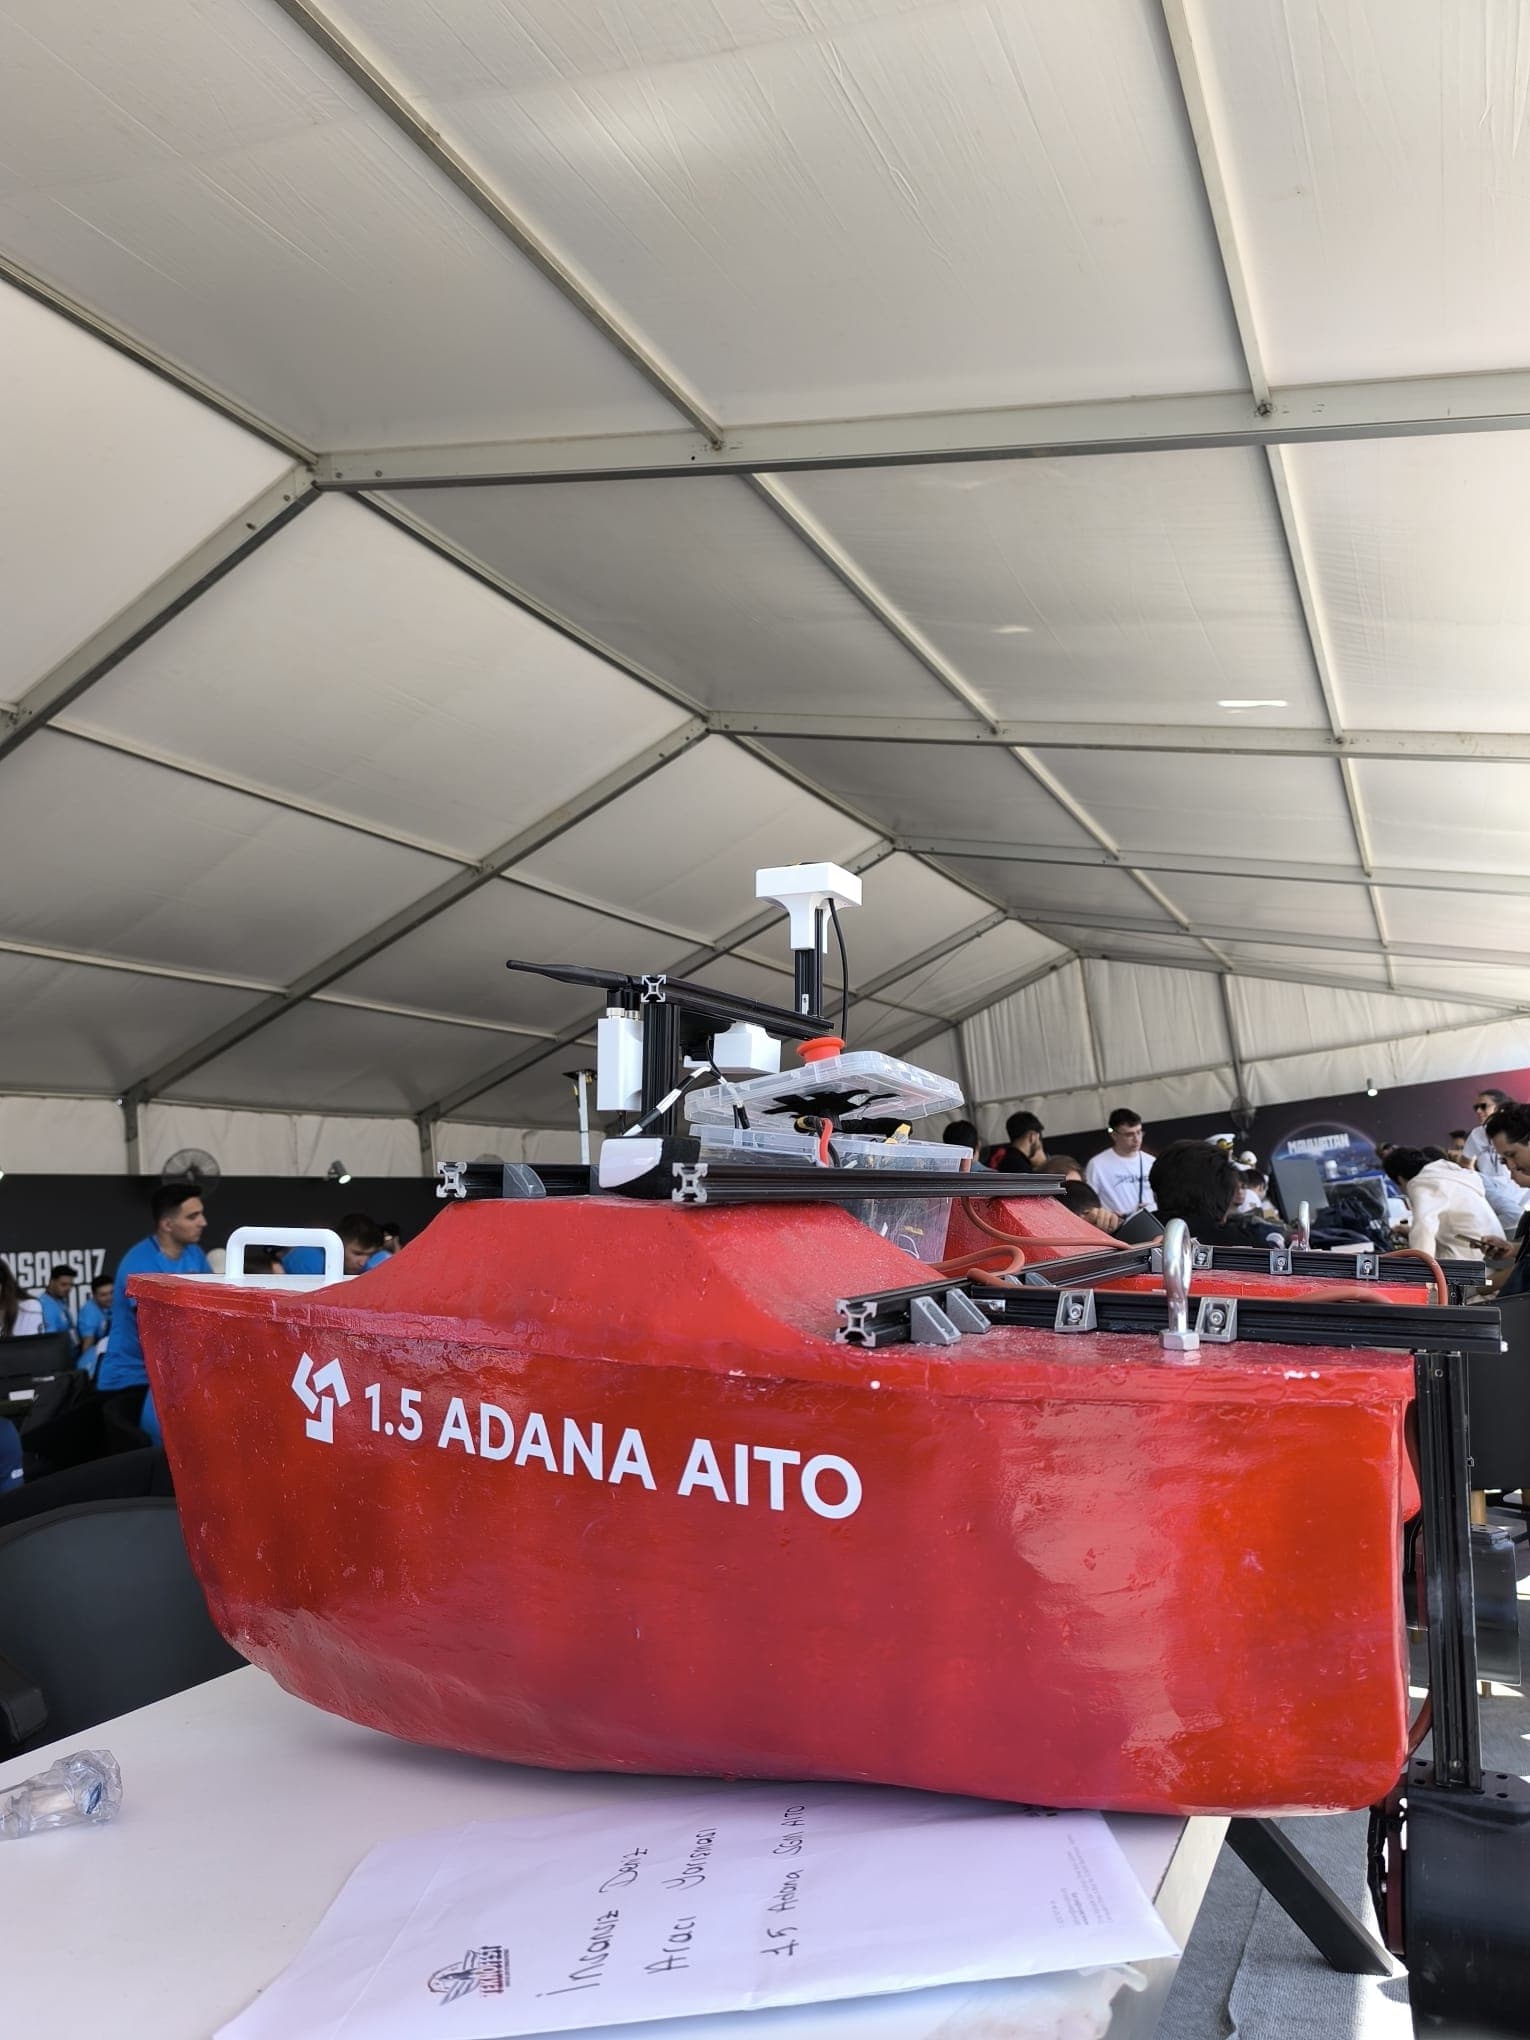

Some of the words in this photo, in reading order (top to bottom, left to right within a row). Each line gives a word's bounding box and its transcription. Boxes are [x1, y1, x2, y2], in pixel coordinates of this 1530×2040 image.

[364, 1382, 423, 1442] 1.5
[437, 1397, 658, 1491] ADANA
[676, 1438, 863, 1520] AITO
[768, 1869, 804, 1914] Adana
